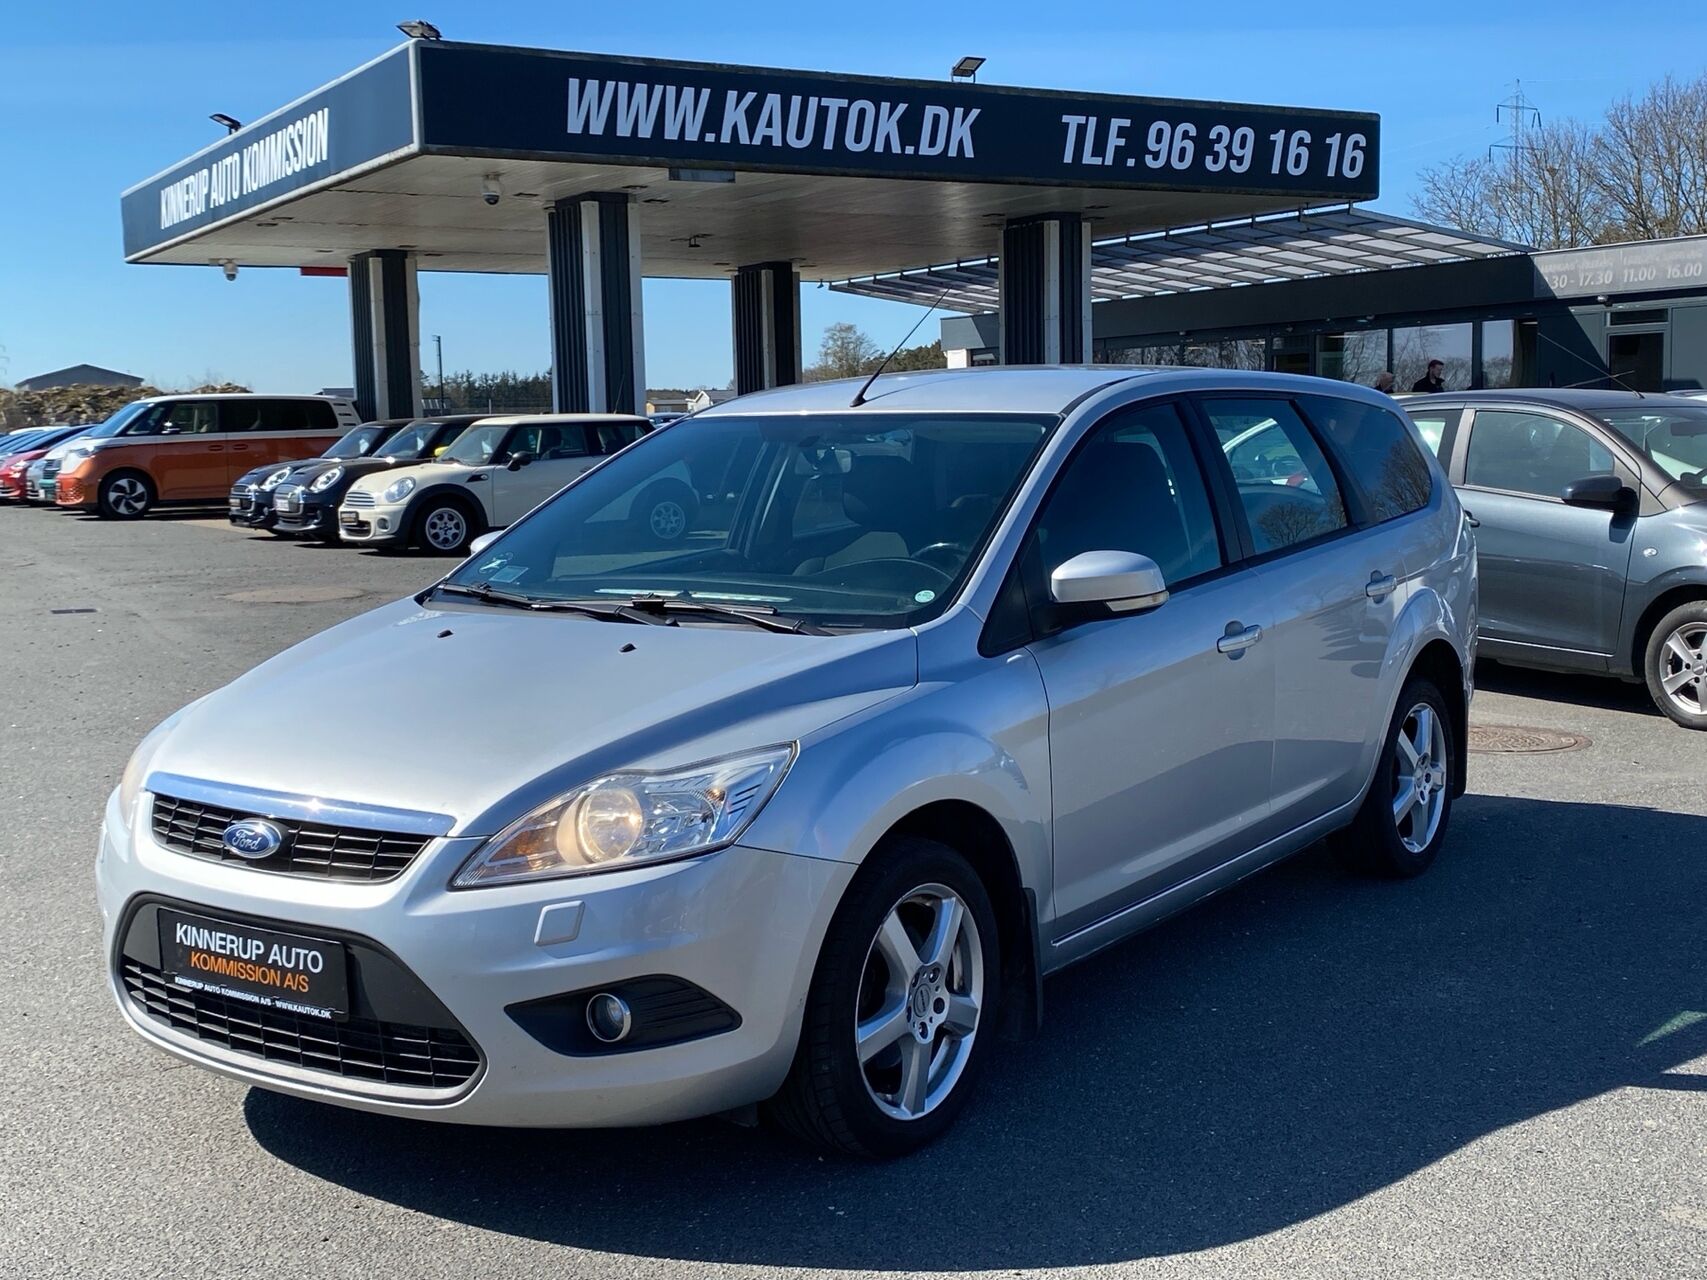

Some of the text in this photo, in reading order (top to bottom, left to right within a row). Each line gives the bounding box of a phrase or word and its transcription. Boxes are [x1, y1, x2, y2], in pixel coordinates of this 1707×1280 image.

[567, 78, 981, 159] WWW.KAUTOK.DK
[160, 108, 329, 229] KINNERUP AUTO KOMMISSION
[1061, 114, 1367, 179] TLF. 96 39 16 16
[1579, 270, 1613, 287] 17.30
[1623, 262, 1702, 283] 11.00 16.00
[232, 829, 262, 850] Ford
[176, 922, 323, 973] KINNERUP AUTO
[191, 952, 309, 993] KOMMISSION A/S
[174, 976, 204, 990] KINNERUP
[204, 983, 221, 995] AUTO
[221, 988, 260, 1004] KOMMISSION
[275, 1000, 332, 1020] WWW.KAUTOK.DK
